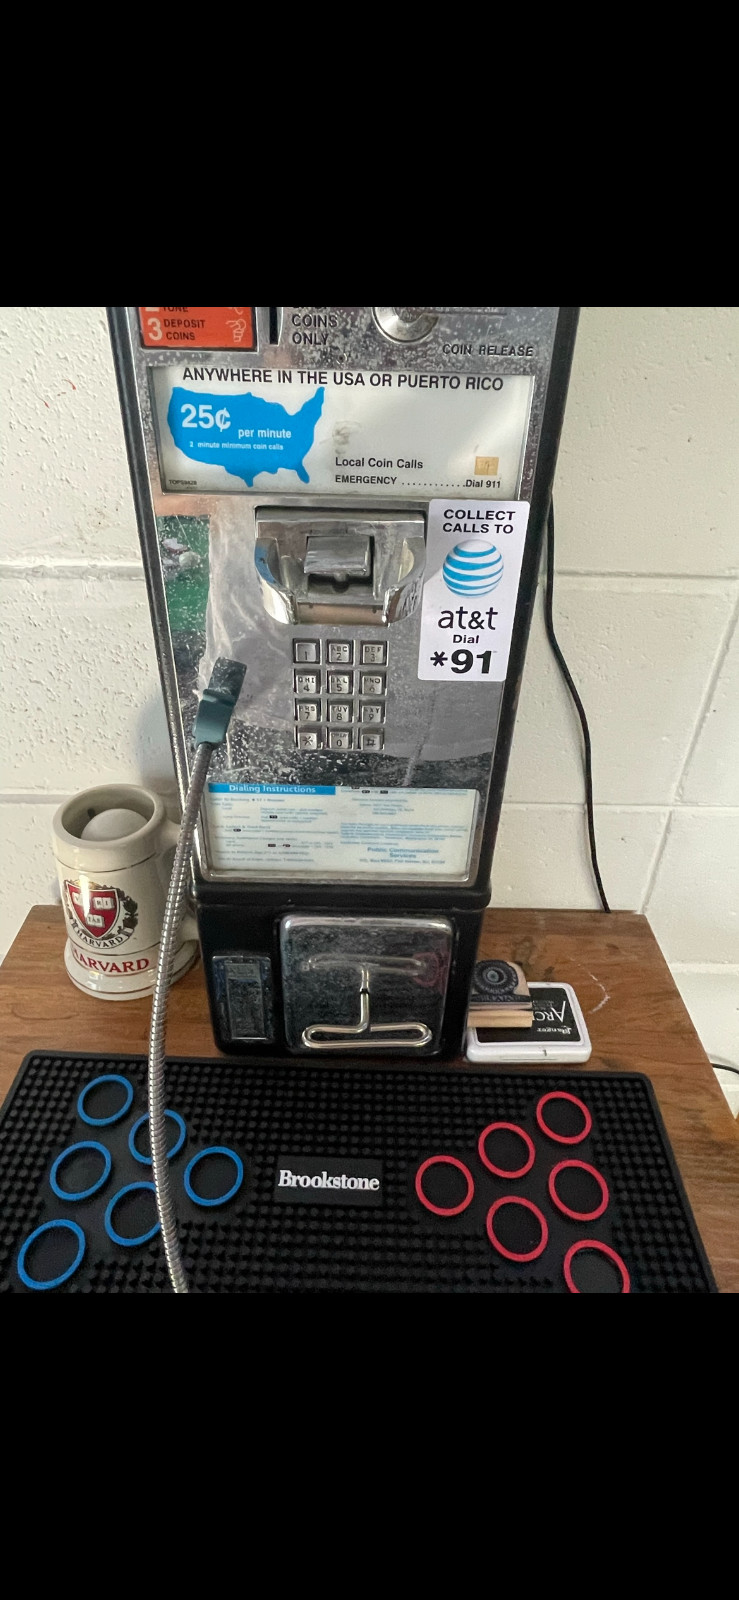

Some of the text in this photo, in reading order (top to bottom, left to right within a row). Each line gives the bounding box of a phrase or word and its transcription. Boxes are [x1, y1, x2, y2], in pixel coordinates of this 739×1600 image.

[292, 314, 338, 327] COINS
[148, 318, 205, 341] 3 DEPOSIT
[166, 332, 195, 340] COINS
[292, 332, 329, 345] ONLY
[443, 344, 534, 356] COIN RELEASE
[183, 367, 503, 391] ANYWHERE IN THE USA OR PUERTO RICO
[181, 403, 231, 432] 25¢
[238, 428, 292, 439] per minute
[336, 457, 423, 469] Local Coin Calls
[335, 475, 397, 485] EMERGENCY
[486, 480, 501, 488] 911
[443, 509, 516, 521] COLLECT
[442, 523, 514, 534] CALLS TO
[438, 607, 498, 630] at&t
[453, 635, 479, 644] Dial
[336, 653, 342, 661] 2
[229, 785, 316, 793] Dialing Instructions
[77, 931, 124, 948] HARVARD
[533, 1001, 566, 1022] ARC
[278, 1170, 380, 1190] Brookstone
